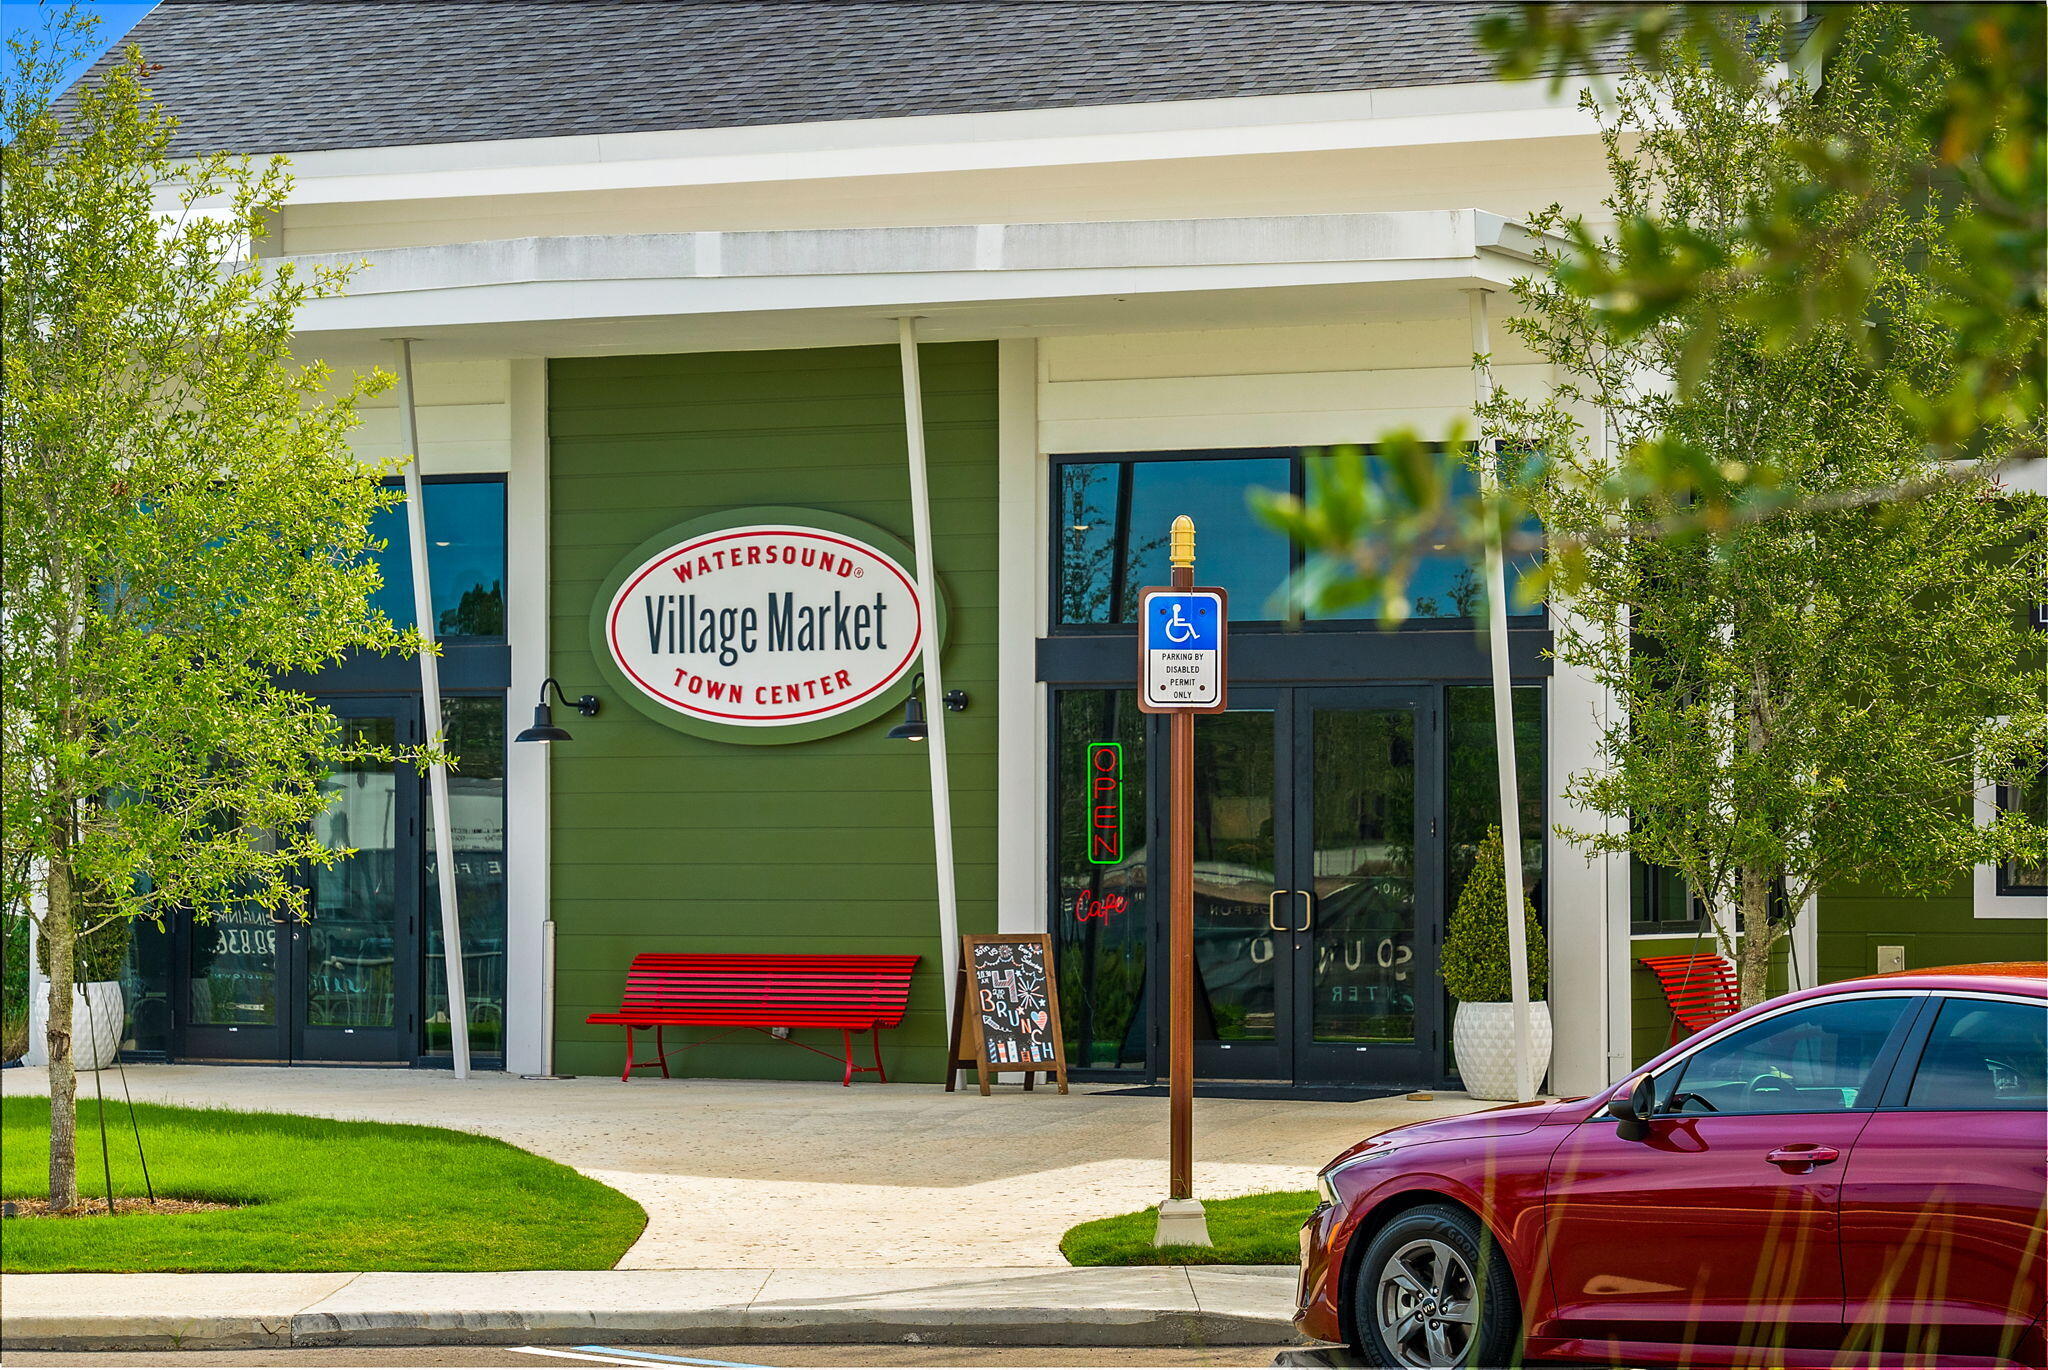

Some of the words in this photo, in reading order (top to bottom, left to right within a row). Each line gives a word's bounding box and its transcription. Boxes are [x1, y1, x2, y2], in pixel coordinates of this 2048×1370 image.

[645, 594, 757, 667] Village
[767, 590, 887, 652] Market
[1161, 653, 1193, 661] PARKING
[1194, 653, 1204, 661] BY
[1166, 666, 1200, 674] DISABLED
[673, 667, 743, 705] TOWN
[755, 669, 852, 705] CENTER
[1170, 678, 1196, 686] PERMIT
[1173, 691, 1192, 699] ONLY
[1094, 748, 1118, 857] OPEN
[974, 945, 991, 957] Join
[979, 989, 1055, 1060] BRUNCH
